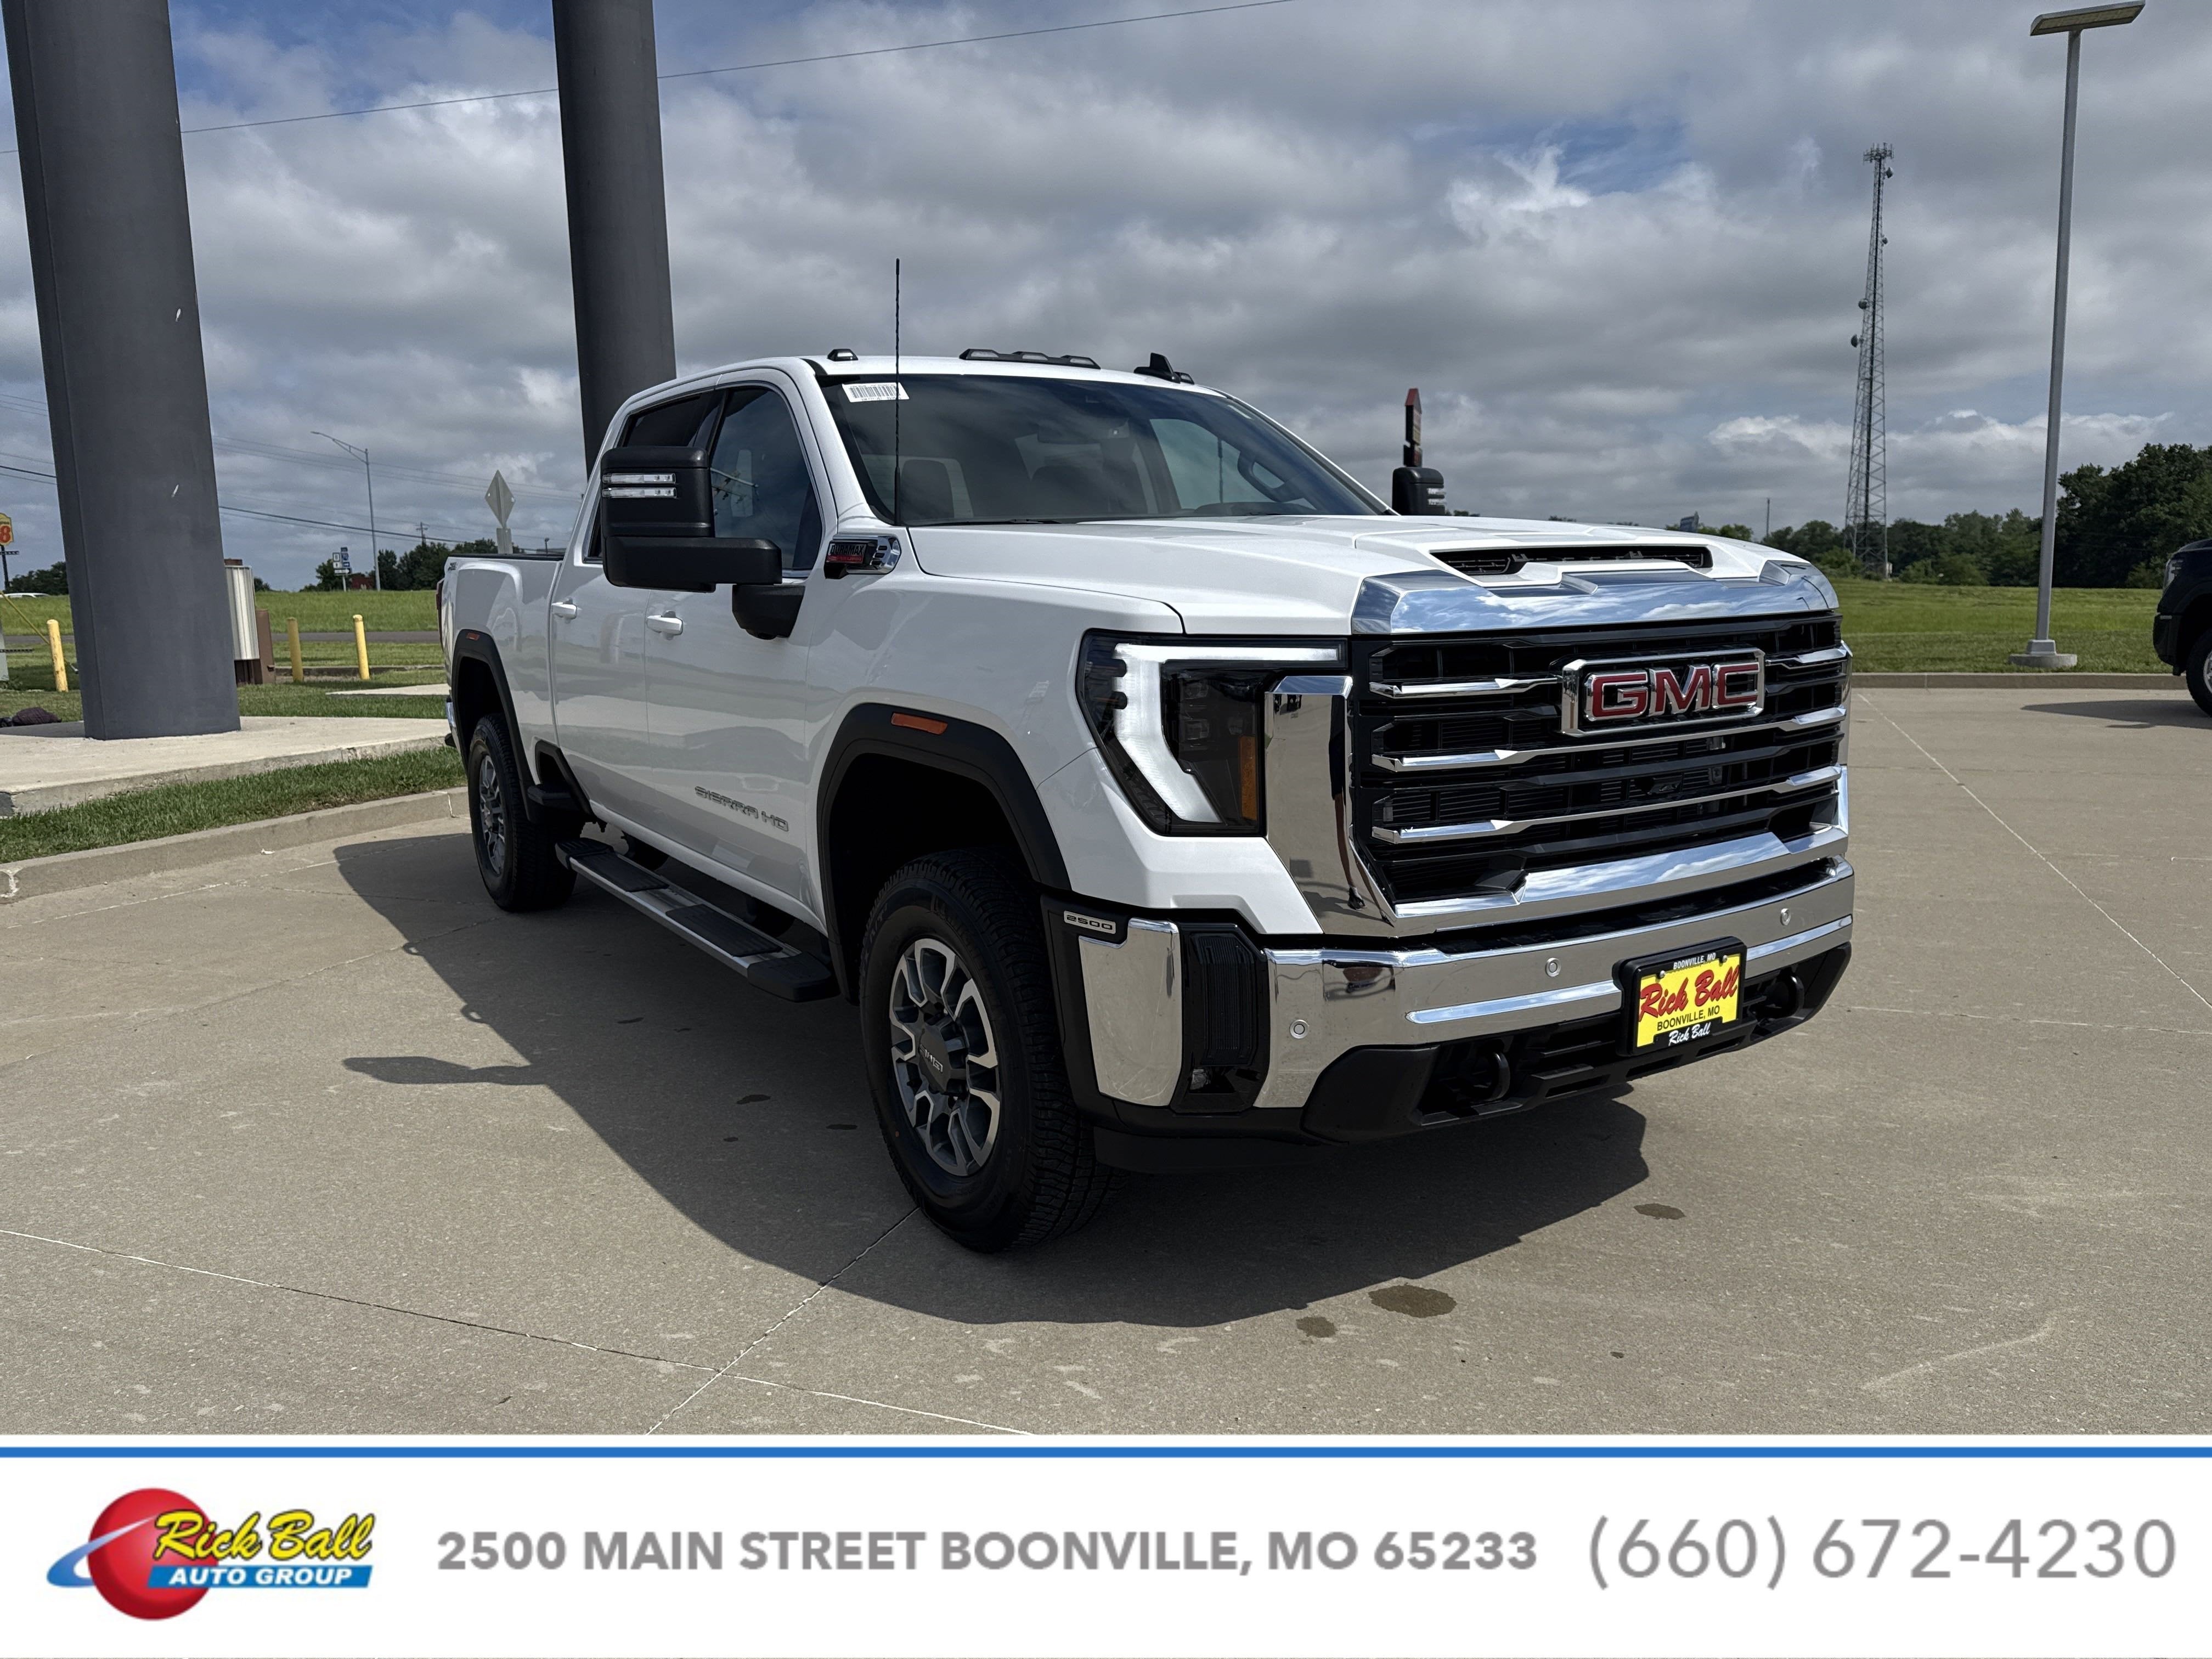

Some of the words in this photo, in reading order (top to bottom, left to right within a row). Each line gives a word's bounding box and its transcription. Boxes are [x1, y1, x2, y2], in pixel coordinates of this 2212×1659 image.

[830, 543, 864, 555] DURAMAX
[1584, 662, 1759, 721] GMC
[695, 786, 759, 819] SIERRA
[761, 811, 789, 832] HD
[1066, 915, 1113, 930] 2500
[1673, 955, 1706, 970] BOONVILLE,
[1707, 952, 1716, 963] MO
[1639, 977, 1689, 1022] Rick
[1695, 964, 1740, 1007] Ball
[1657, 1009, 1706, 1031] BOONVILLE,
[1708, 1005, 1720, 1017] MO
[1668, 1027, 1690, 1046] Rick
[1691, 1022, 1711, 1039] Ball
